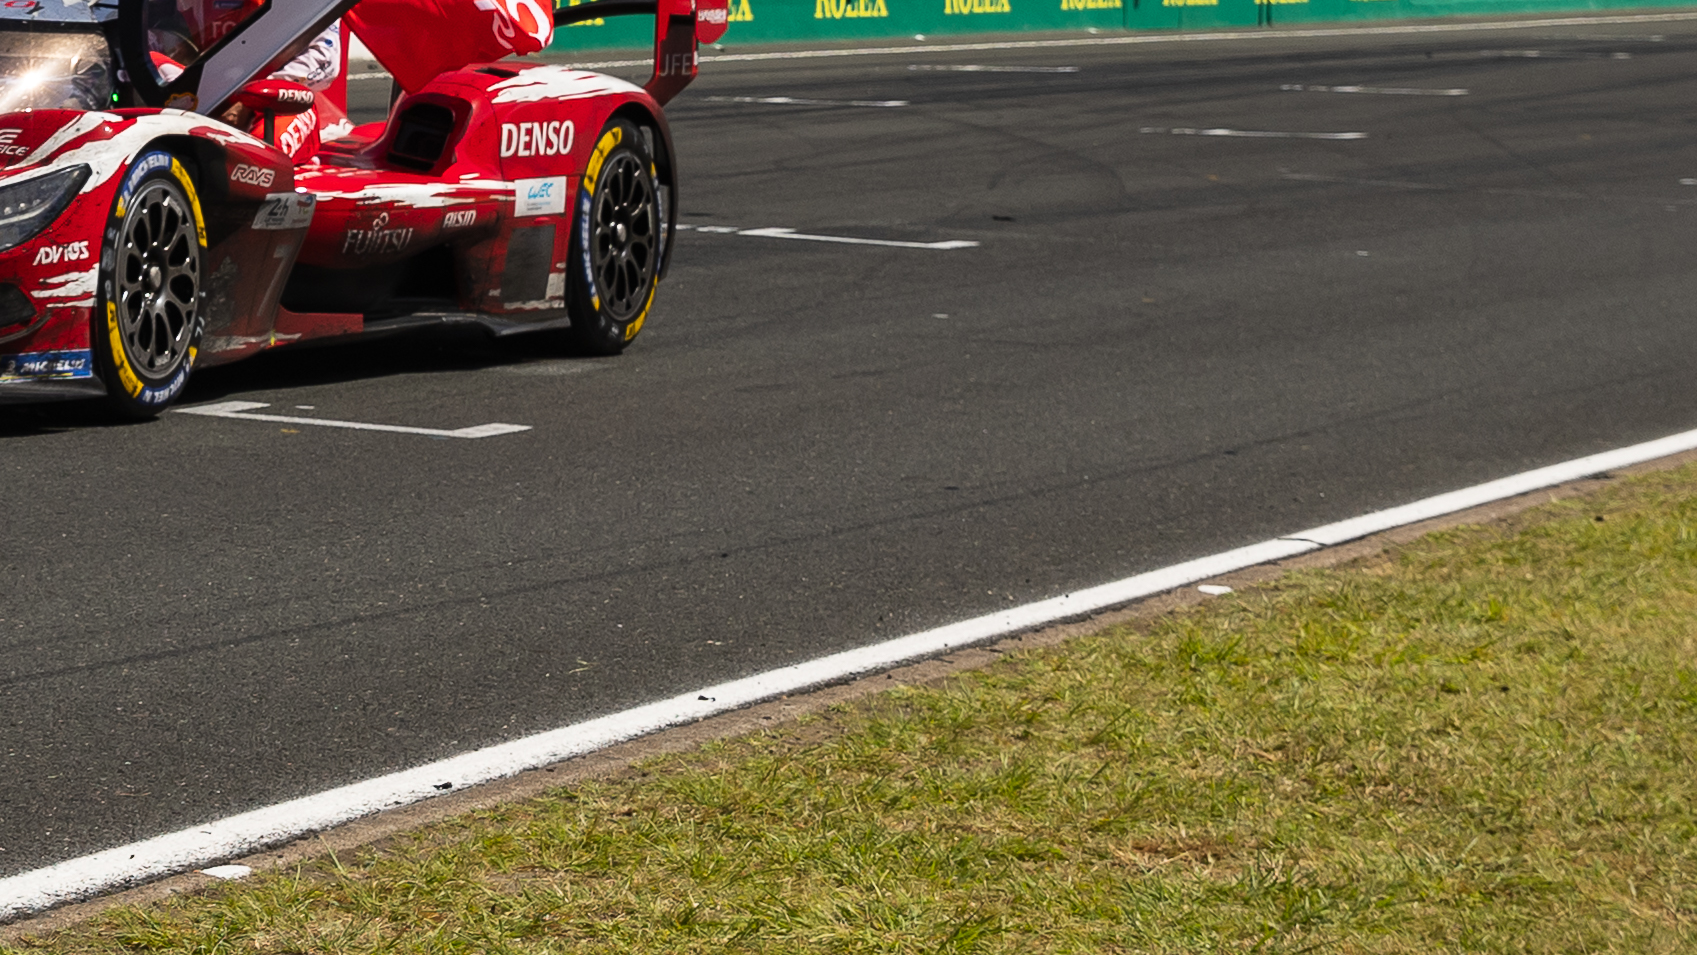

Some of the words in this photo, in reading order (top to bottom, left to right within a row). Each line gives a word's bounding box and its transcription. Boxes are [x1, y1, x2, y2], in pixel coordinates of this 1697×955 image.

[659, 52, 693, 77] JFE
[277, 88, 314, 105] DENSO
[500, 119, 575, 159] DENSO
[230, 164, 276, 188] RAYS
